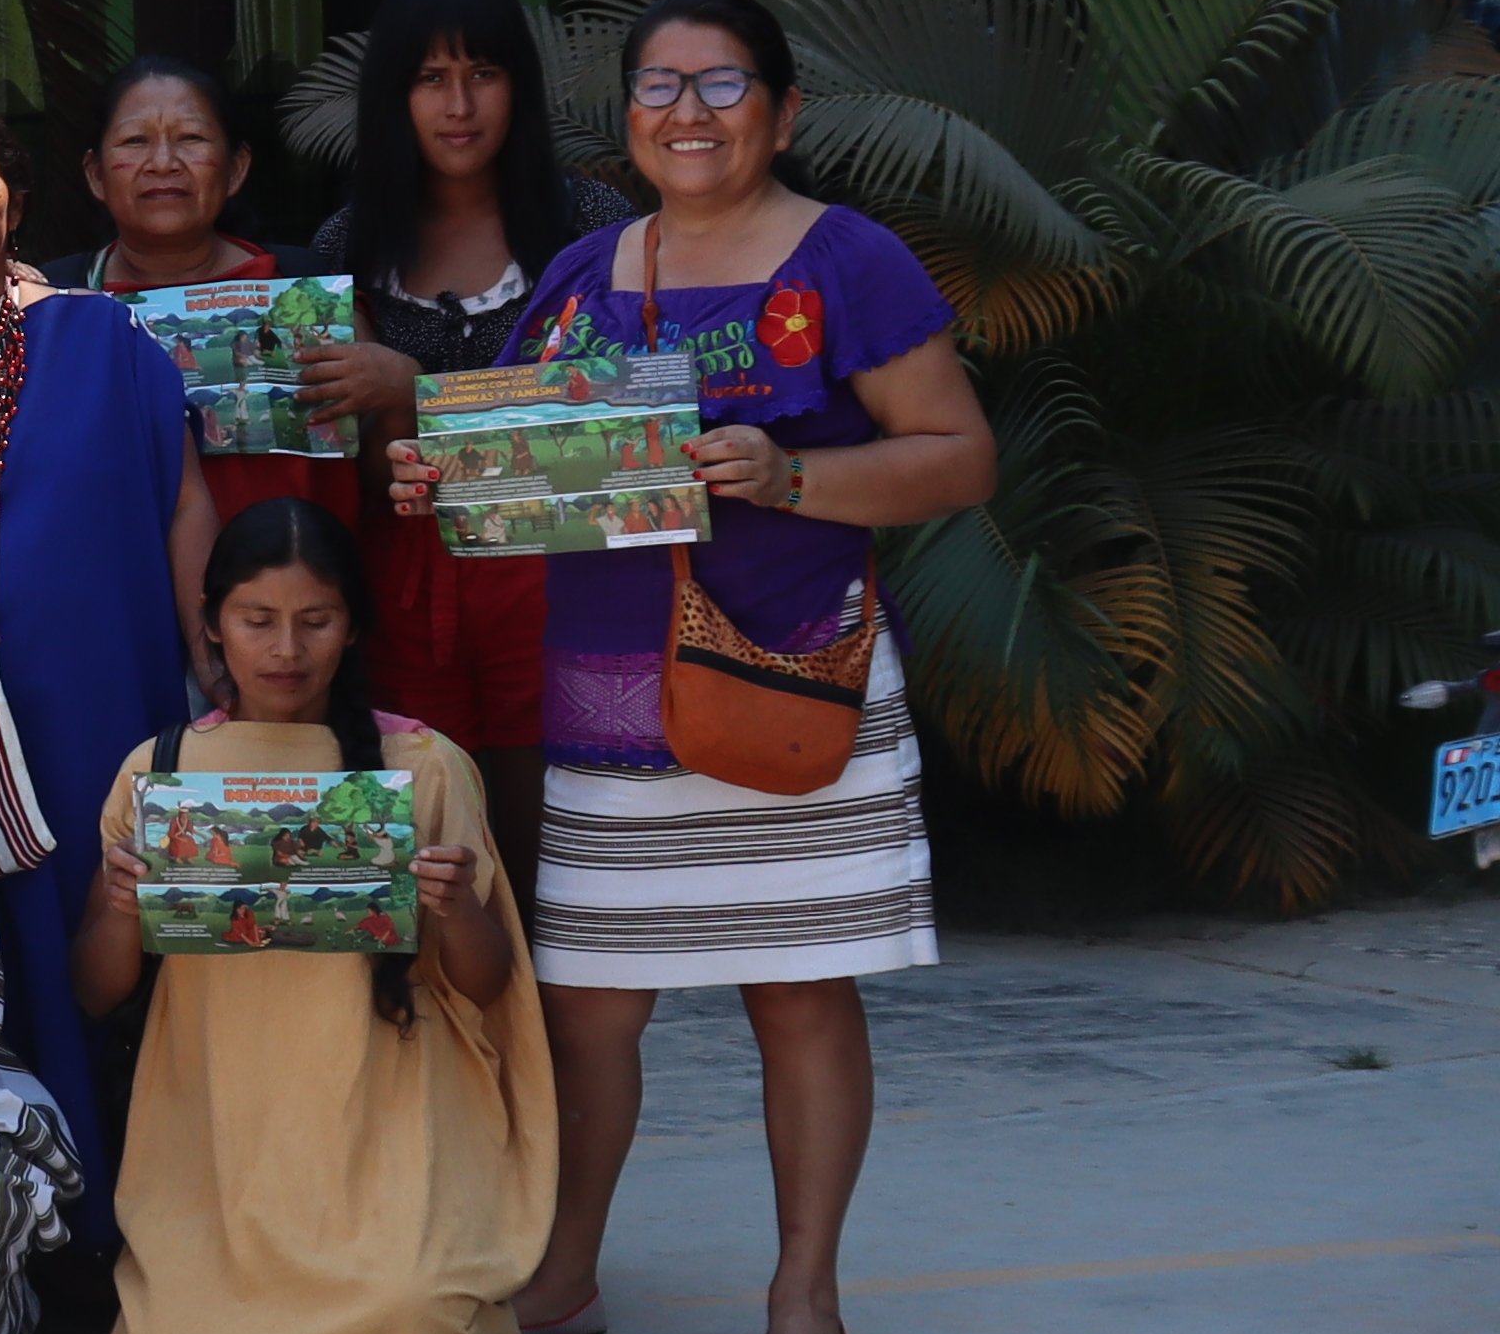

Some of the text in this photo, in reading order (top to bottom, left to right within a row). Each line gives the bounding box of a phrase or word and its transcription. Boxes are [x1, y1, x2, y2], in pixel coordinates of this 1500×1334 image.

[456, 370, 505, 382] INVITAMOS
[507, 370, 515, 378] A
[518, 368, 534, 376] VER
[455, 382, 487, 392] MUNDO
[489, 380, 510, 389] CON
[512, 378, 537, 386] OJOS
[510, 386, 561, 399] YANESHA
